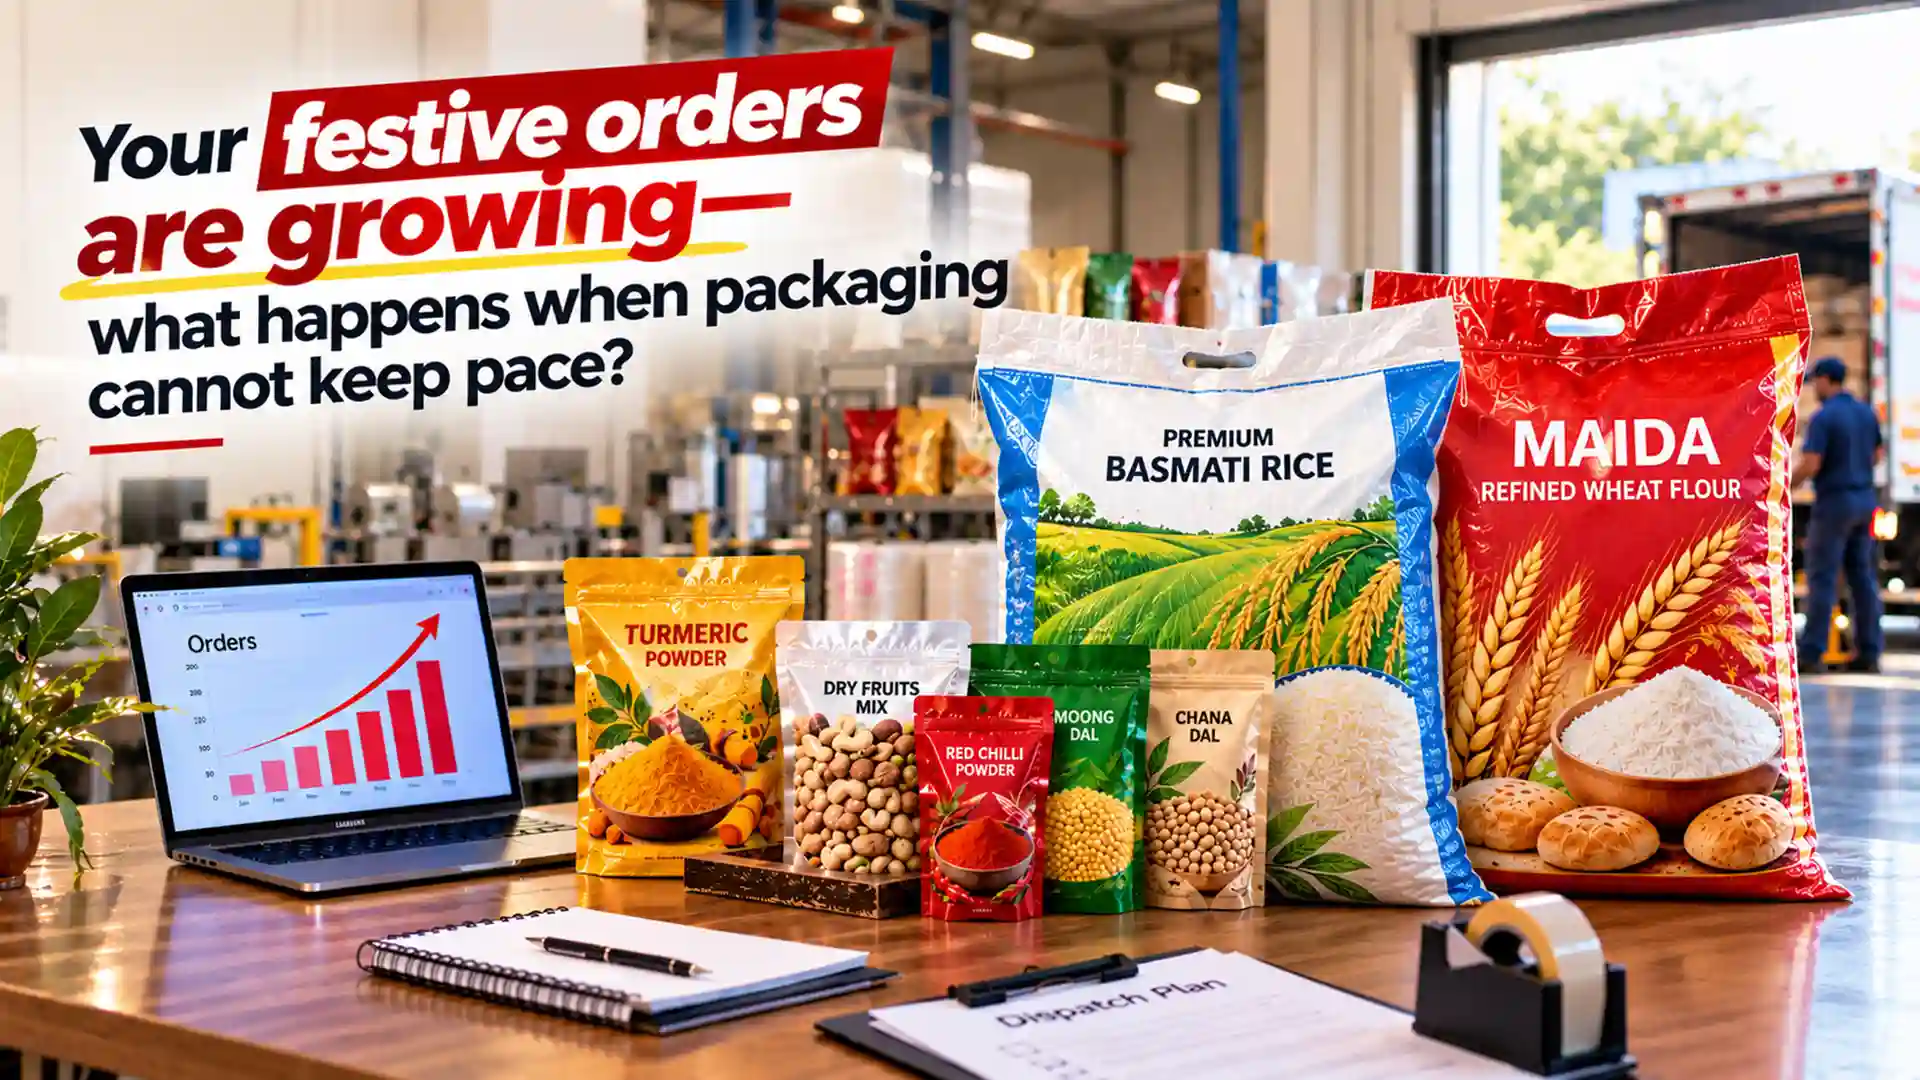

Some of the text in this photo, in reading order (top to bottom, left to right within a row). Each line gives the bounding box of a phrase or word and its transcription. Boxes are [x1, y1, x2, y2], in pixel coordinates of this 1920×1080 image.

[1164, 429, 1273, 447] PREMIUM
[1515, 418, 1720, 466] MAIDA
[1107, 452, 1334, 482] BASMATI RICE
[1482, 479, 1740, 501] REFINED WHEAT FLOUR
[625, 623, 748, 645] TURMERIC
[188, 633, 257, 653] Orders
[646, 650, 727, 667] POWDER
[824, 681, 920, 696] DRY FRUITS
[857, 700, 887, 714] MIX
[1054, 710, 1114, 725] MOONG
[1176, 711, 1232, 724] CHANA
[1070, 728, 1099, 742] DAL
[1190, 729, 1220, 742] DAL
[946, 746, 1023, 760] RED CHILLI
[956, 764, 1015, 777] POWDER
[997, 978, 1227, 1027] Dispatch Plan
